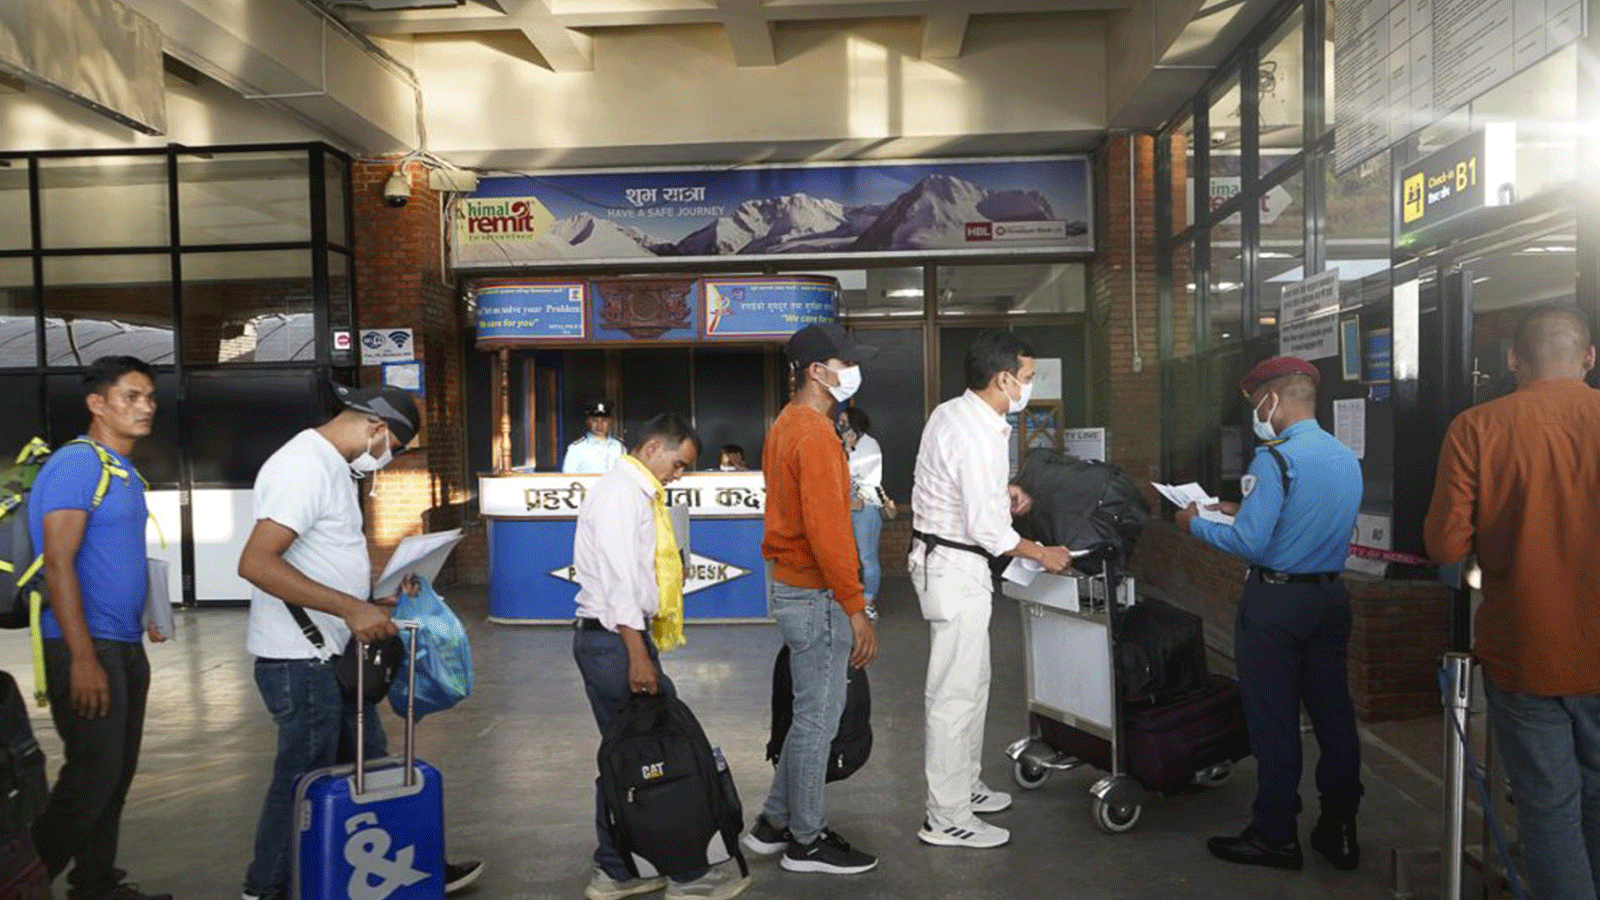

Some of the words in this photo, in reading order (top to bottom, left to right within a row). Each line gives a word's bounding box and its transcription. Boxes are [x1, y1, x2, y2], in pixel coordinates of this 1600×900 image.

[1455, 157, 1477, 192] B1
[625, 187, 658, 207] शुभ
[662, 186, 706, 203] यात्रा
[1211, 181, 1240, 196] ima
[468, 201, 510, 216] himal
[607, 208, 636, 218] HAVE
[637, 208, 645, 218] A
[647, 207, 674, 218] SAFE
[677, 206, 726, 217] JOURNEY
[468, 206, 535, 233] remit
[524, 481, 587, 512] प्रहरी
[688, 564, 728, 580] DESK
[641, 761, 666, 779] CAT
